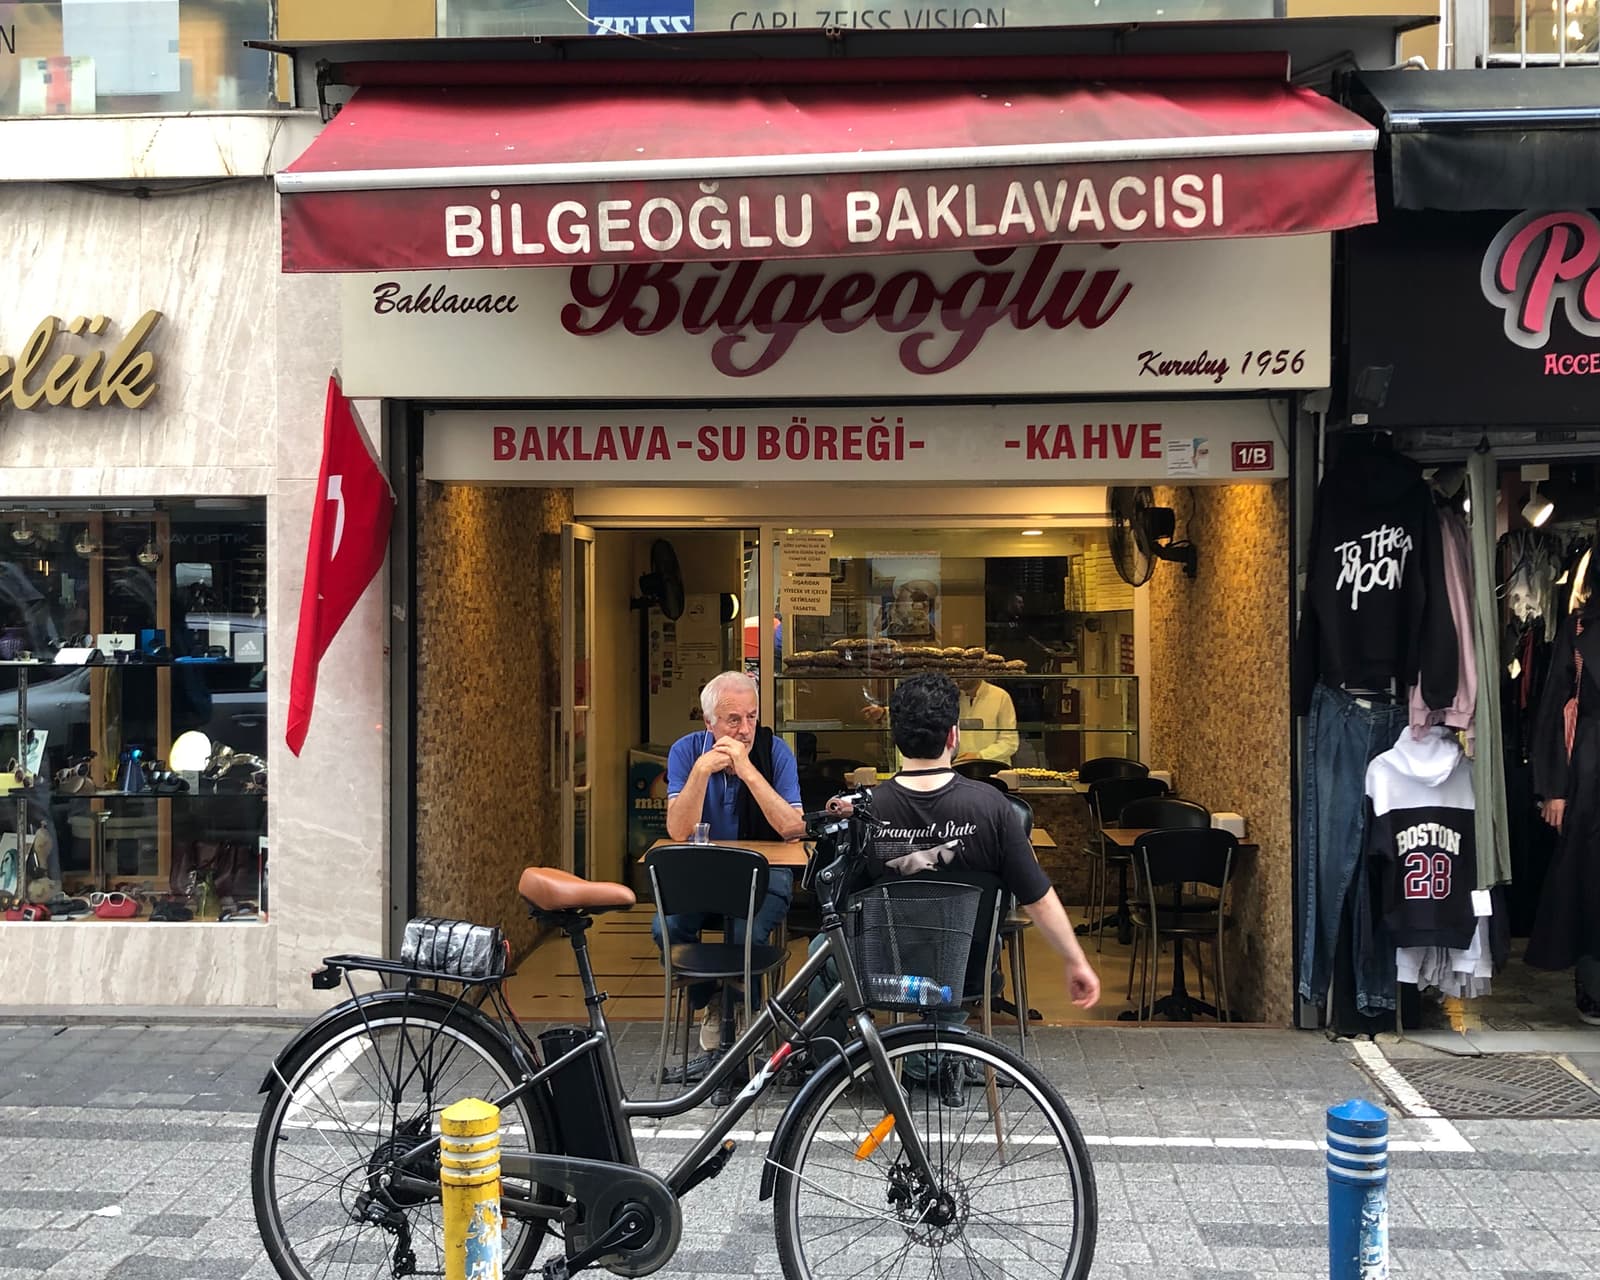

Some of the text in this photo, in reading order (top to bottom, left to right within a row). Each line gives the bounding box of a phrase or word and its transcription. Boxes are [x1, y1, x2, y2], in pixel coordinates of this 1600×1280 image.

[445, 173, 1223, 257] BİLGEOĞLU BAKLAVACISI
[373, 282, 519, 314] Baklavacı
[1138, 350, 1306, 383] Kuruluş 1956
[1239, 448, 1266, 464] 1/B
[873, 820, 977, 844] Tranquil State
[1396, 823, 1461, 856] BOSTON
[1404, 852, 1451, 899] 28
